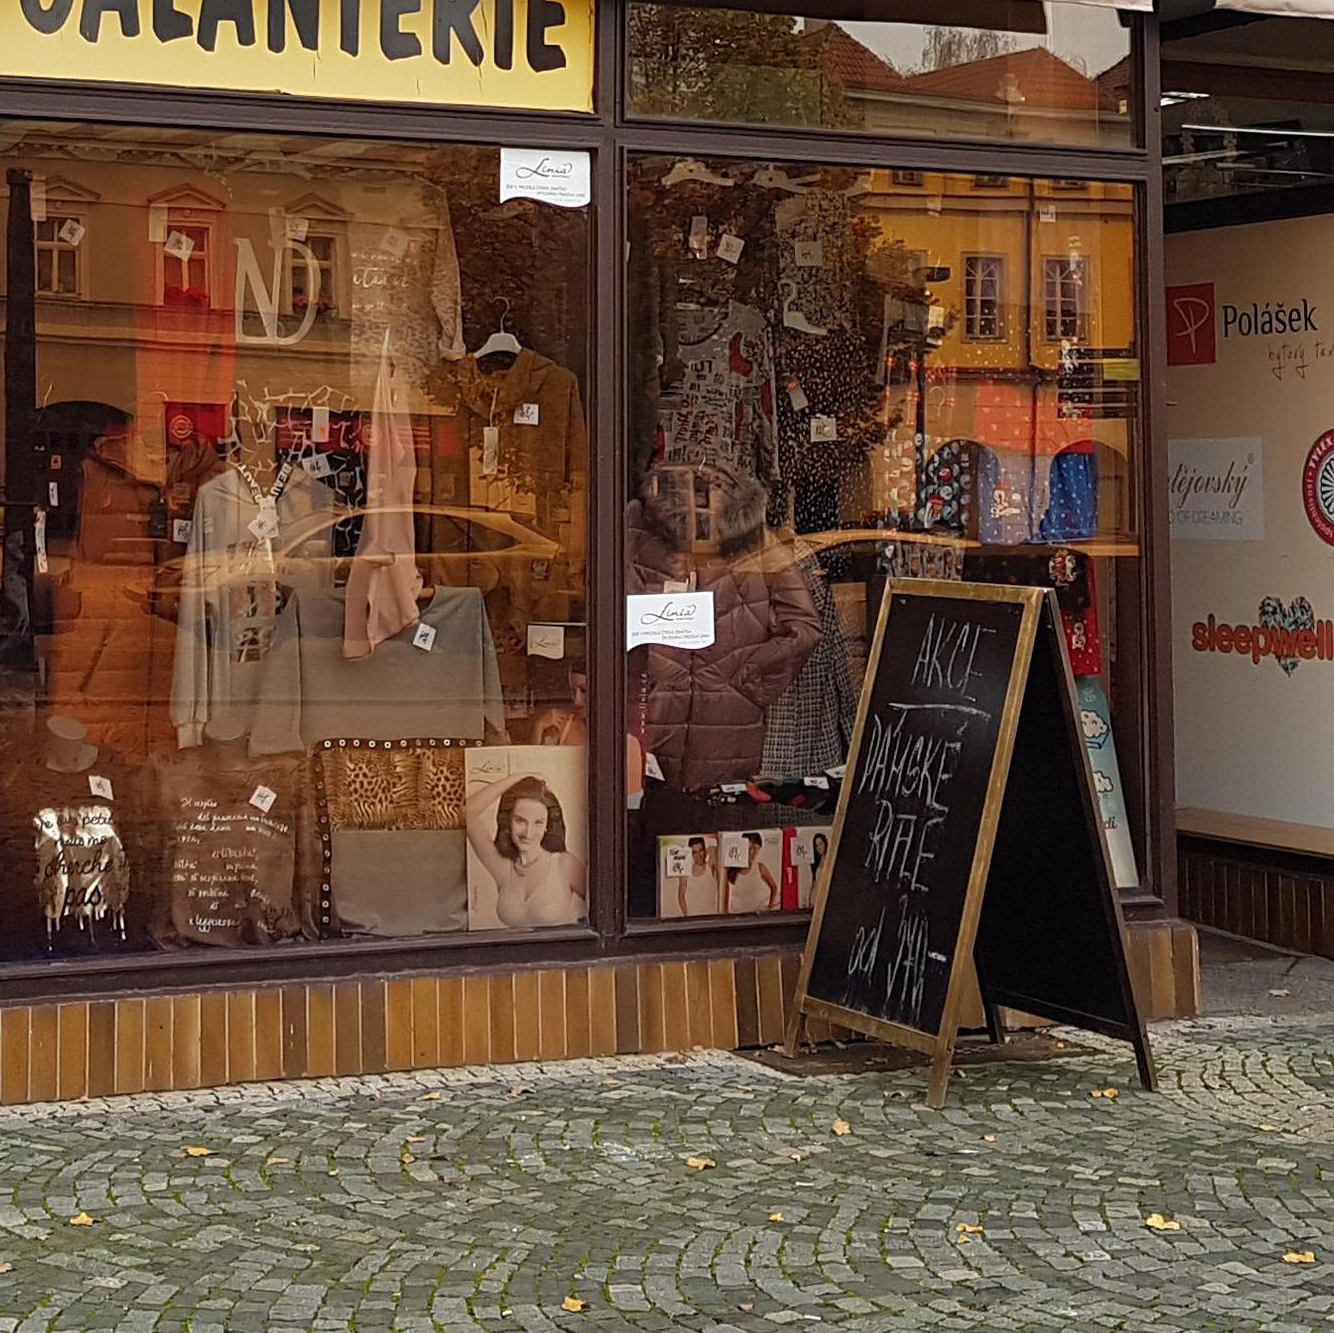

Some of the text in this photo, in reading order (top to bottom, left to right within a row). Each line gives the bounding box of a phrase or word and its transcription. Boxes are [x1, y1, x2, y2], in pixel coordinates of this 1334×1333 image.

[1222, 299, 1318, 337] Polášek
[1167, 460, 1248, 509] tějovský
[911, 613, 996, 702] AKCE
[1192, 613, 1334, 665] sleepwell
